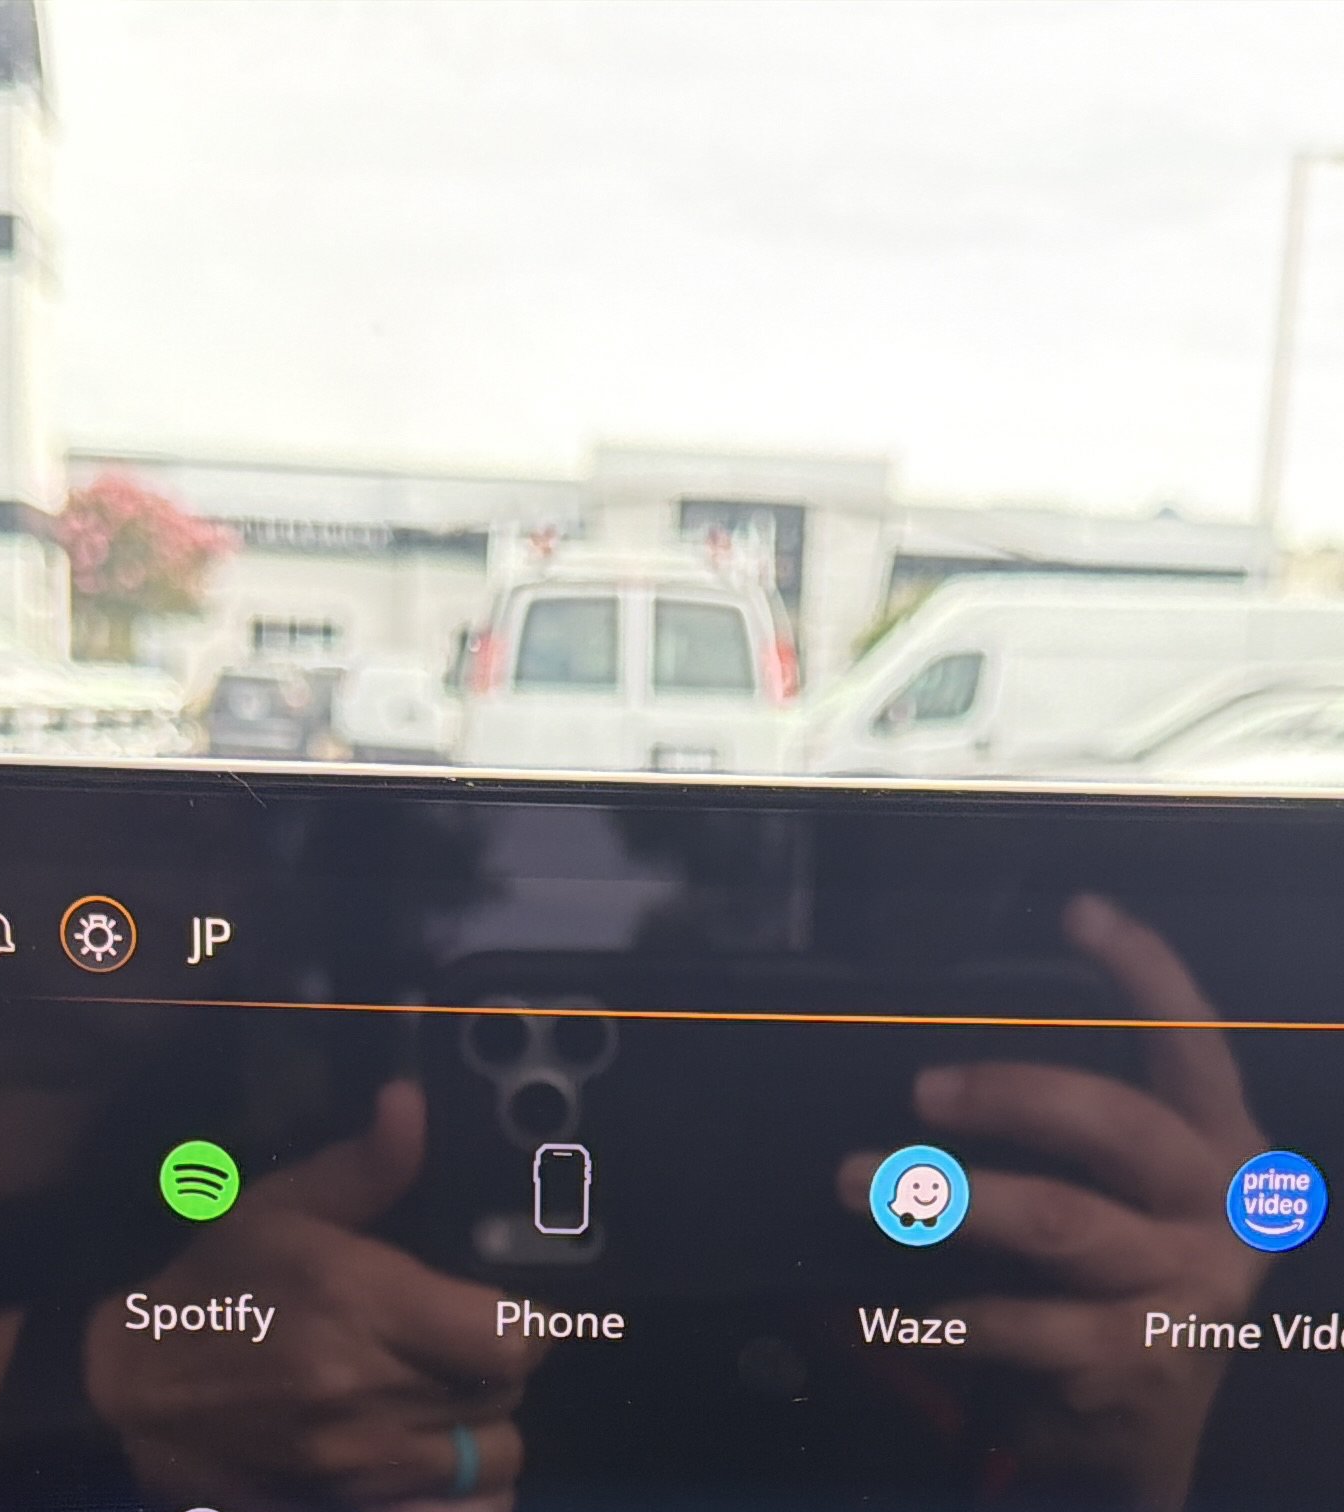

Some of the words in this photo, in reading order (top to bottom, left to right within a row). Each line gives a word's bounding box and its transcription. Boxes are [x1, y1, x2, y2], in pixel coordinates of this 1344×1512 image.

[187, 917, 231, 964] JP
[1244, 1168, 1310, 1194] prime
[1244, 1193, 1308, 1215] video
[125, 1293, 276, 1343] Spotify
[496, 1299, 625, 1339] Phone
[858, 1307, 967, 1345] Waze
[1144, 1312, 1261, 1349] Prime
